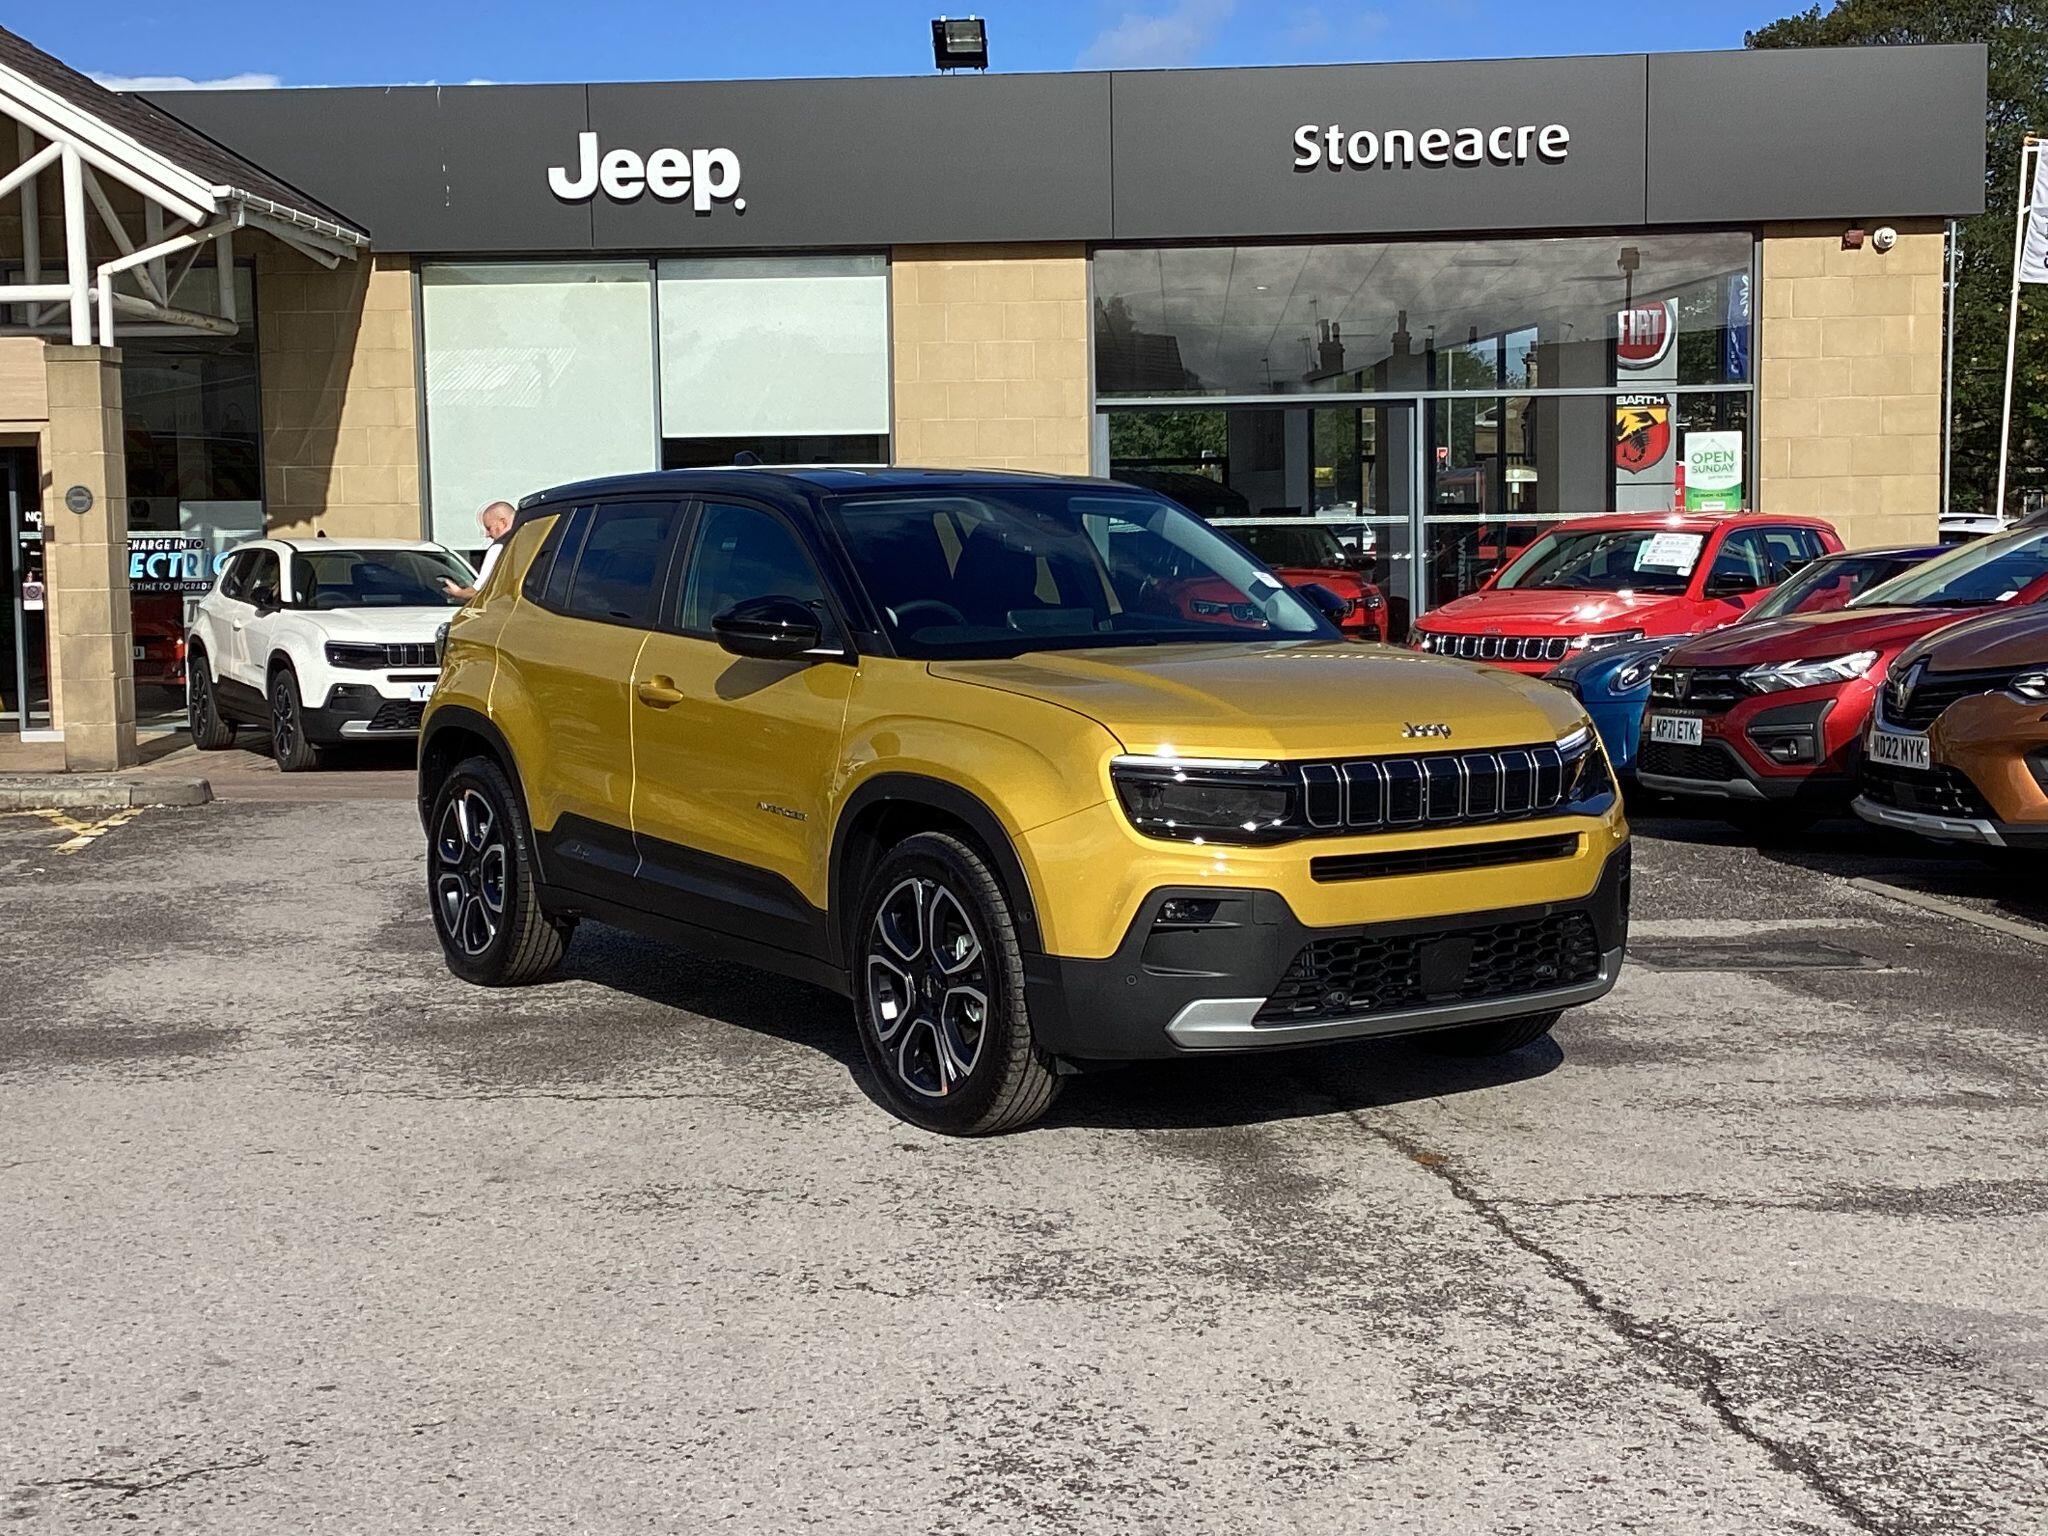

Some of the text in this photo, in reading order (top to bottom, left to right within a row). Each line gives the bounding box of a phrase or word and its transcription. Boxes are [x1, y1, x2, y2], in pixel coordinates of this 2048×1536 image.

[1294, 123, 1570, 167] Stoneacre
[1617, 309, 1663, 346] FIAT
[1691, 450, 1735, 465] OPEN
[1691, 463, 1736, 475] SUNDAY
[137, 582, 156, 591] TIME
[158, 582, 171, 591] TO
[1402, 721, 1452, 739] Jeep
